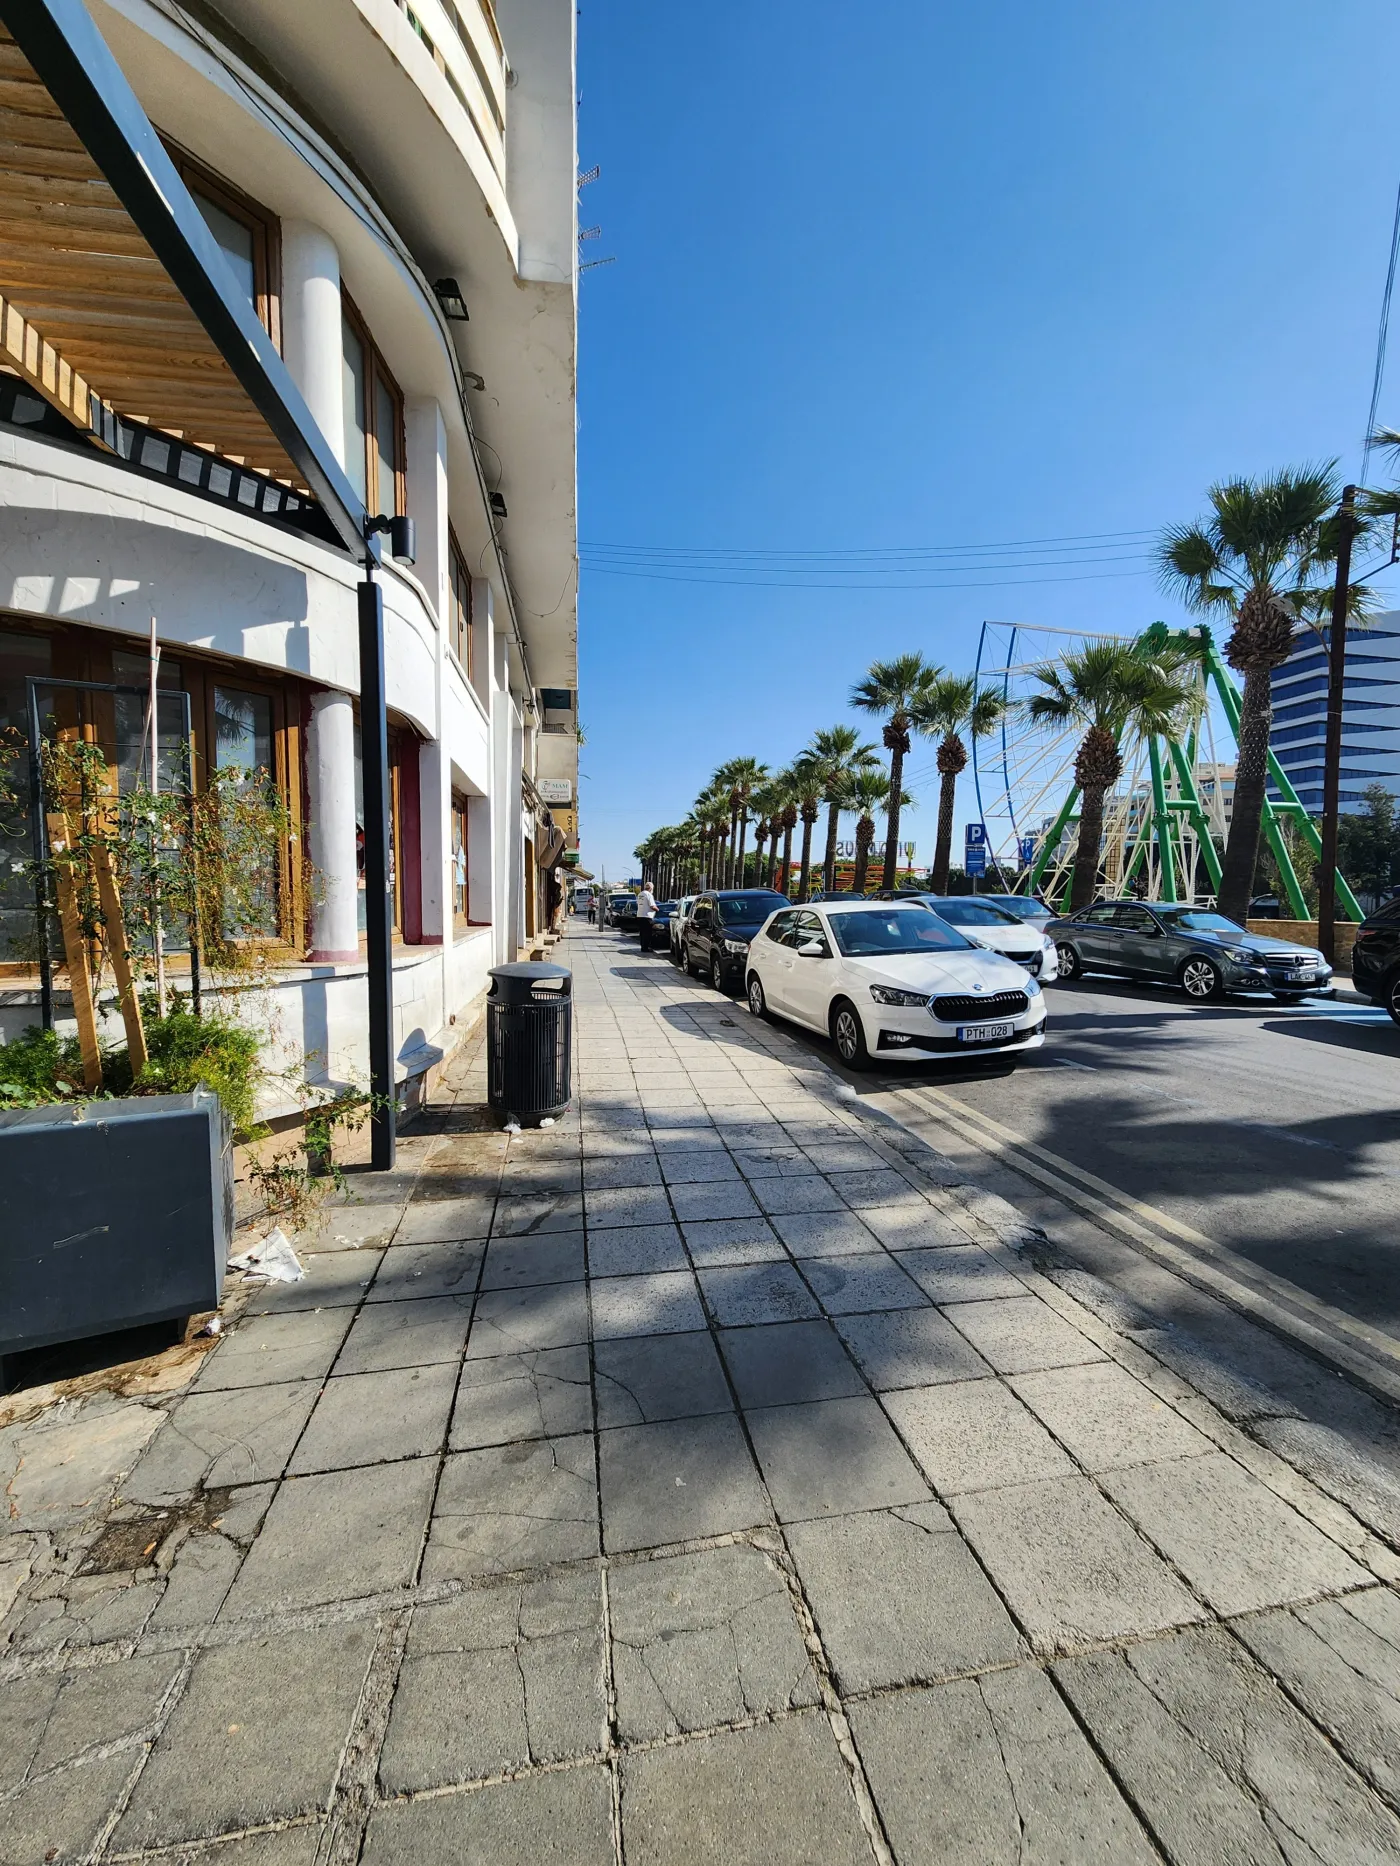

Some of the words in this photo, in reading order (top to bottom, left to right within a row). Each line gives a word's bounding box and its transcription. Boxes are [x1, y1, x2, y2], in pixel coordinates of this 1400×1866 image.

[971, 826, 982, 842] P
[1025, 840, 1031, 850] P
[966, 1028, 986, 1040] PTH
[991, 1026, 1008, 1037] 028
